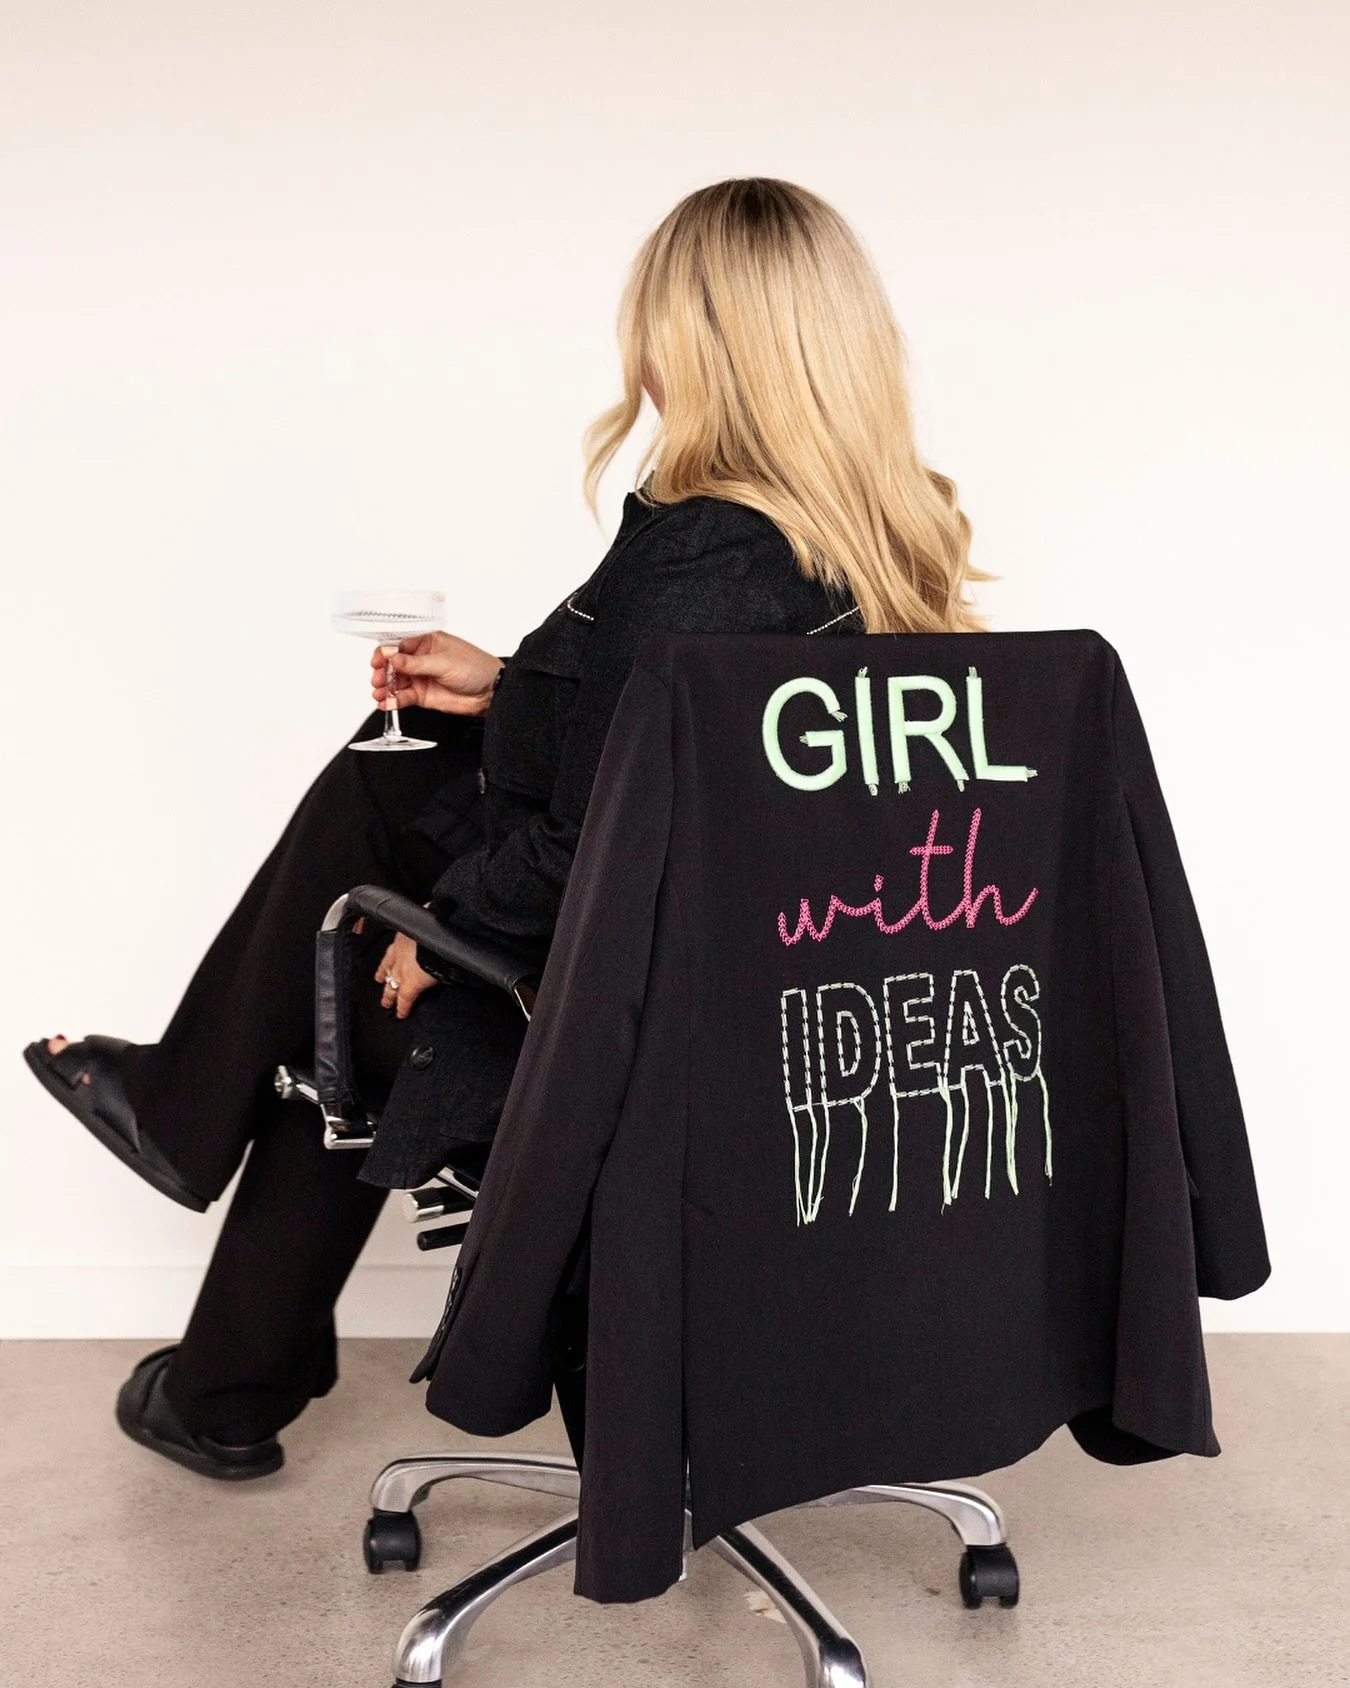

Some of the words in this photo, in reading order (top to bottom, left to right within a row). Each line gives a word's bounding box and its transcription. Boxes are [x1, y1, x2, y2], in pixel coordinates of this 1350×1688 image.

[762, 667, 1038, 796] GIRL
[778, 808, 1039, 946] with
[780, 964, 1042, 1113] IDEAS
